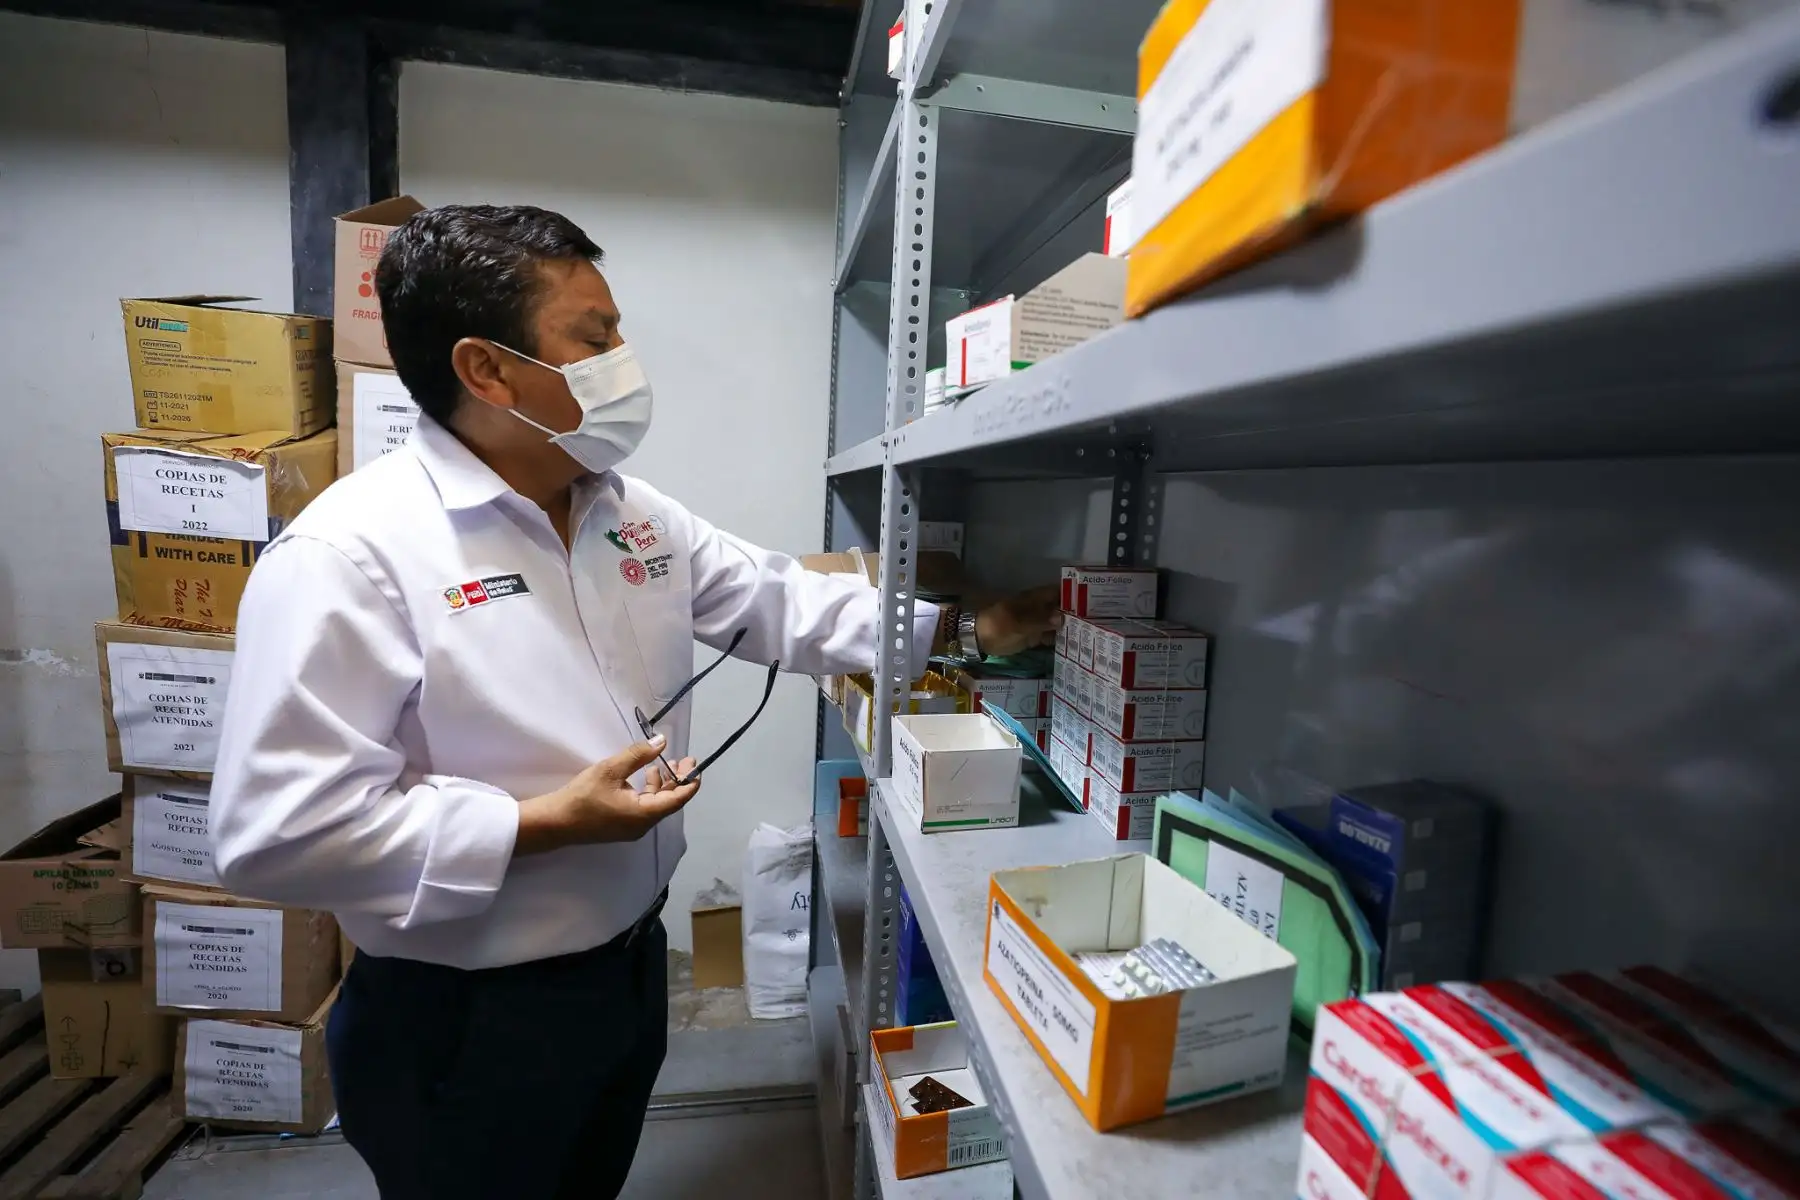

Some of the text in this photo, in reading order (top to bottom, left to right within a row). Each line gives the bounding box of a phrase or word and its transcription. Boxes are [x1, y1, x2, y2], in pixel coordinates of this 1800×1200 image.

[135, 315, 159, 330] Util
[155, 468, 227, 485] COPIAS DE
[161, 484, 224, 499] RECETAS
[181, 520, 209, 531] 2022
[155, 546, 236, 565] WITH CARE
[148, 693, 208, 705] COPIAS DE
[154, 705, 206, 716] RECETAS
[151, 715, 213, 728] ATENDIDAS
[173, 743, 195, 752] 2021
[164, 812, 203, 825] COPIAS
[182, 857, 203, 867] 2020
[189, 942, 245, 953] COPIAS DE
[193, 953, 242, 963] RECETAS
[188, 962, 248, 973] ATENDIDAS
[207, 992, 228, 1000] 2020
[216, 1058, 266, 1071] COPIAS DE
[218, 1069, 264, 1079] RECETAS
[214, 1077, 269, 1089] ATENDIDAS
